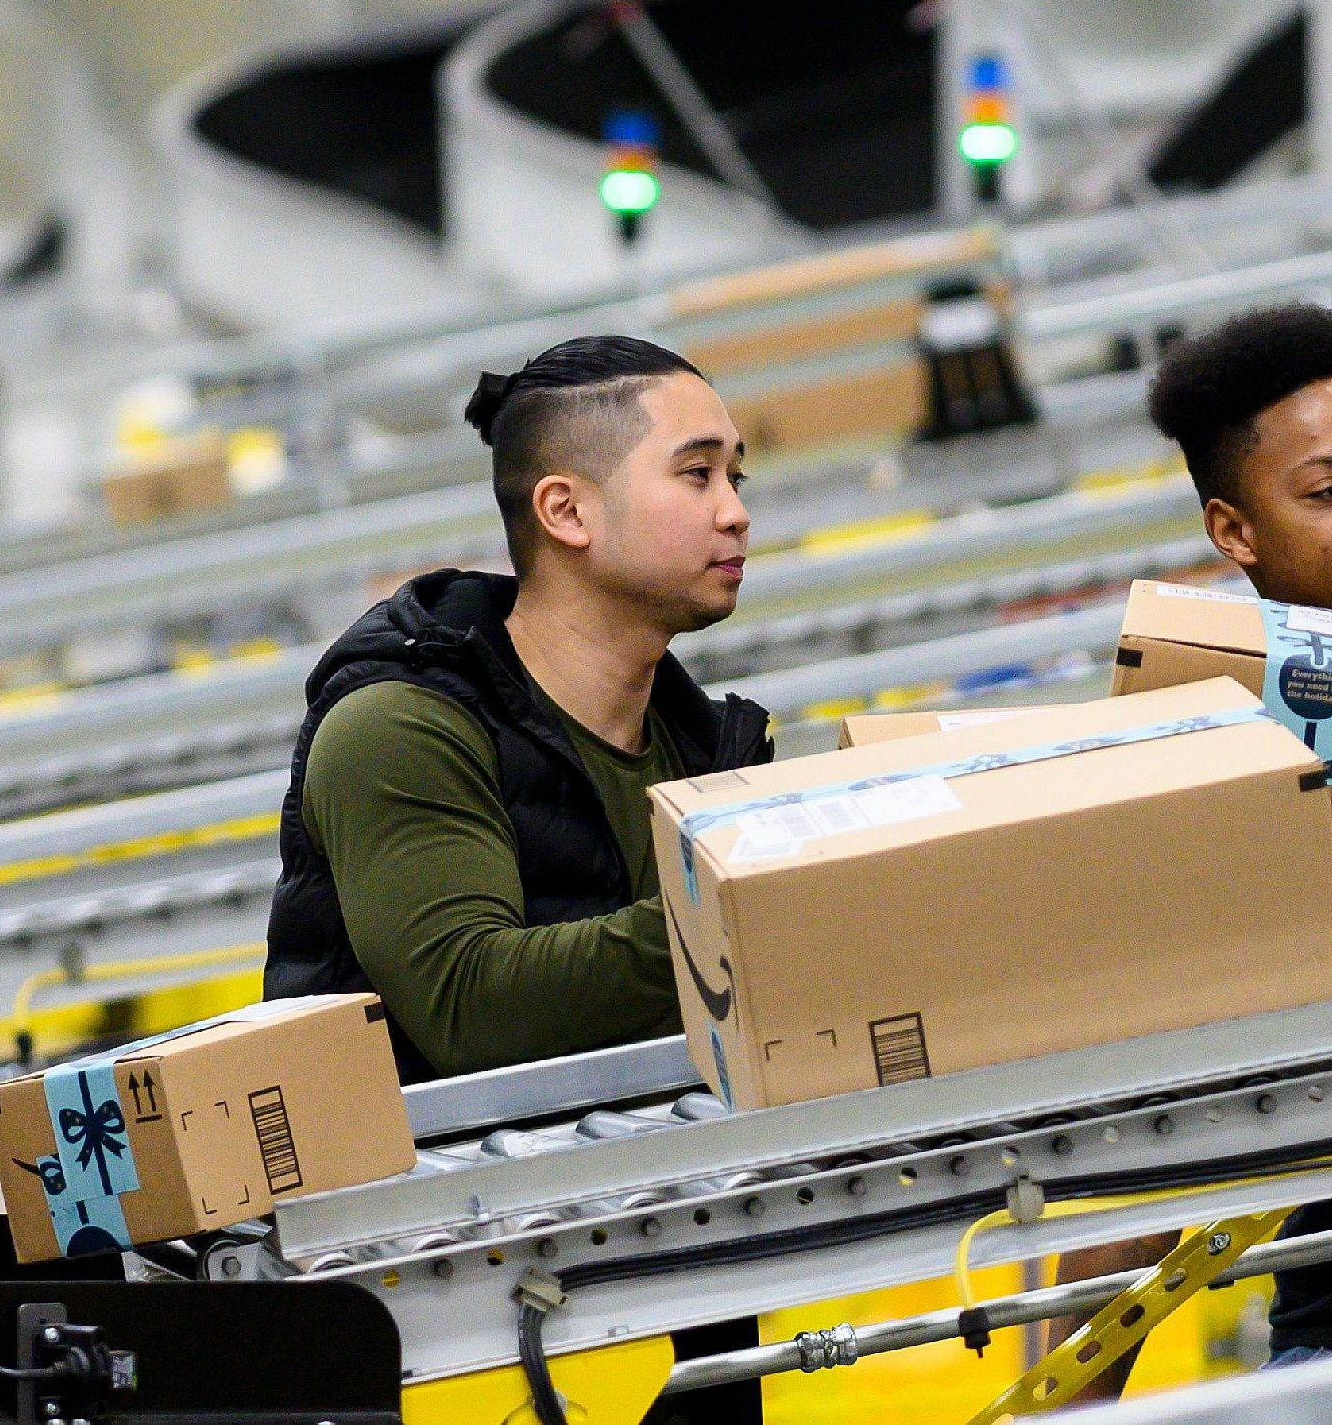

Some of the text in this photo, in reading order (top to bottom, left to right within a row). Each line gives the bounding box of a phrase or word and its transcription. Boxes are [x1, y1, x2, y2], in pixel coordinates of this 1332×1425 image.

[1288, 680, 1305, 689] you
[1307, 682, 1329, 691] need
[1288, 690, 1304, 698] the
